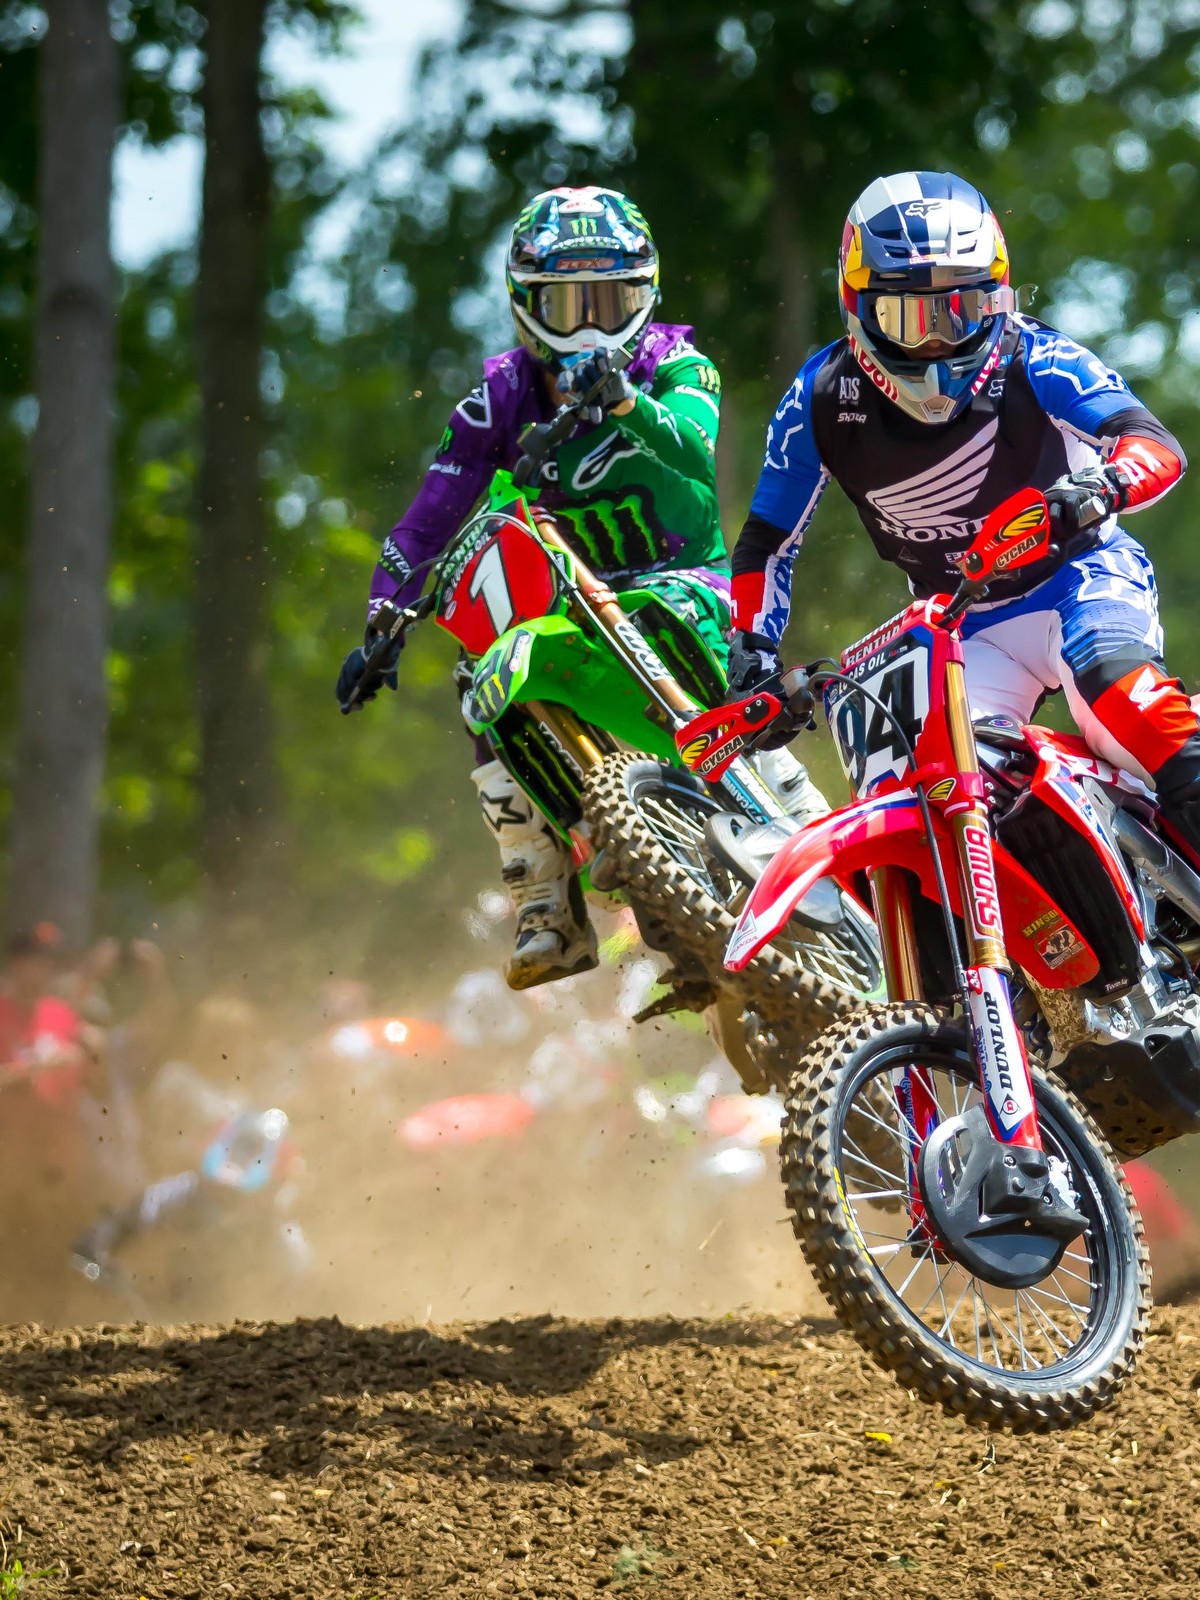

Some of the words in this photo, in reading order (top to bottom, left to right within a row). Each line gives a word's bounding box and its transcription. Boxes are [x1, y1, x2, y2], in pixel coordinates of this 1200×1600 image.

[876, 517, 986, 543] HON
[997, 537, 1037, 568] CYCRA
[468, 541, 515, 639] 1
[868, 652, 886, 672] OIL
[701, 736, 744, 774] CYCRA
[837, 660, 922, 788] 94
[966, 826, 1001, 940] SHOWA
[983, 991, 1014, 1091] DUNLOP
